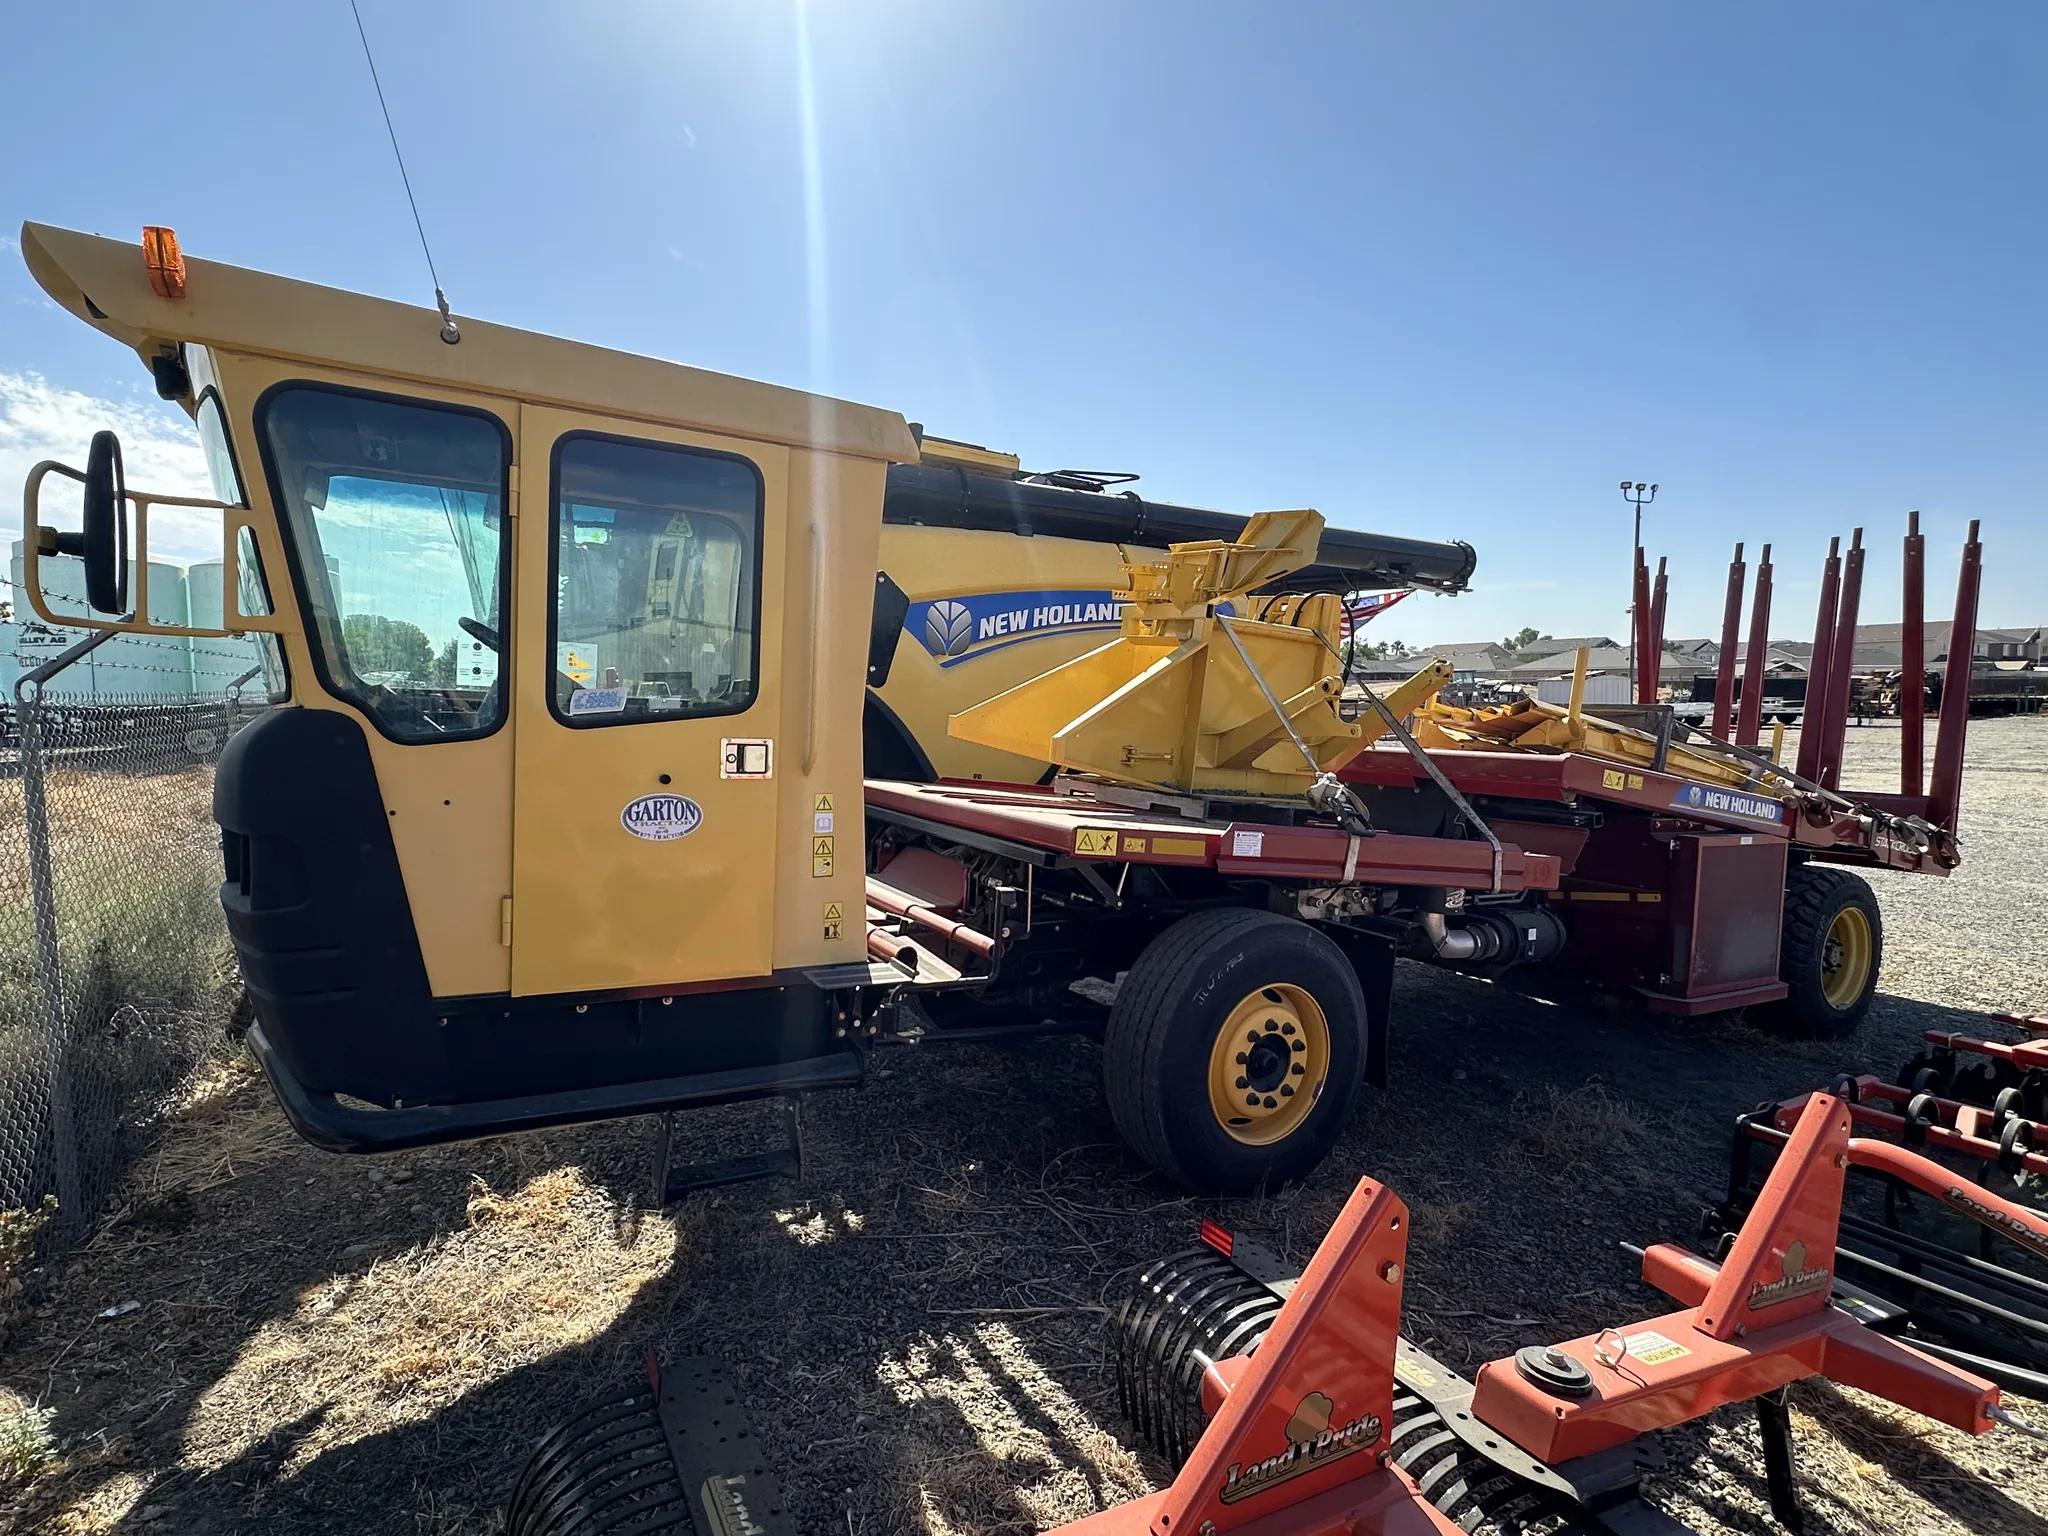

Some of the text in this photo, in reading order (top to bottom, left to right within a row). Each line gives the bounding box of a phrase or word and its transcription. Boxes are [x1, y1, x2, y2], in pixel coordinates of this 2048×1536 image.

[979, 609, 1029, 639] NEW
[627, 799, 696, 821] GARTON
[1705, 791, 1776, 819] NEW HOLLAND
[1750, 1266, 1829, 1302] Land Pride
[1224, 1413, 1382, 1495] Land Pride
